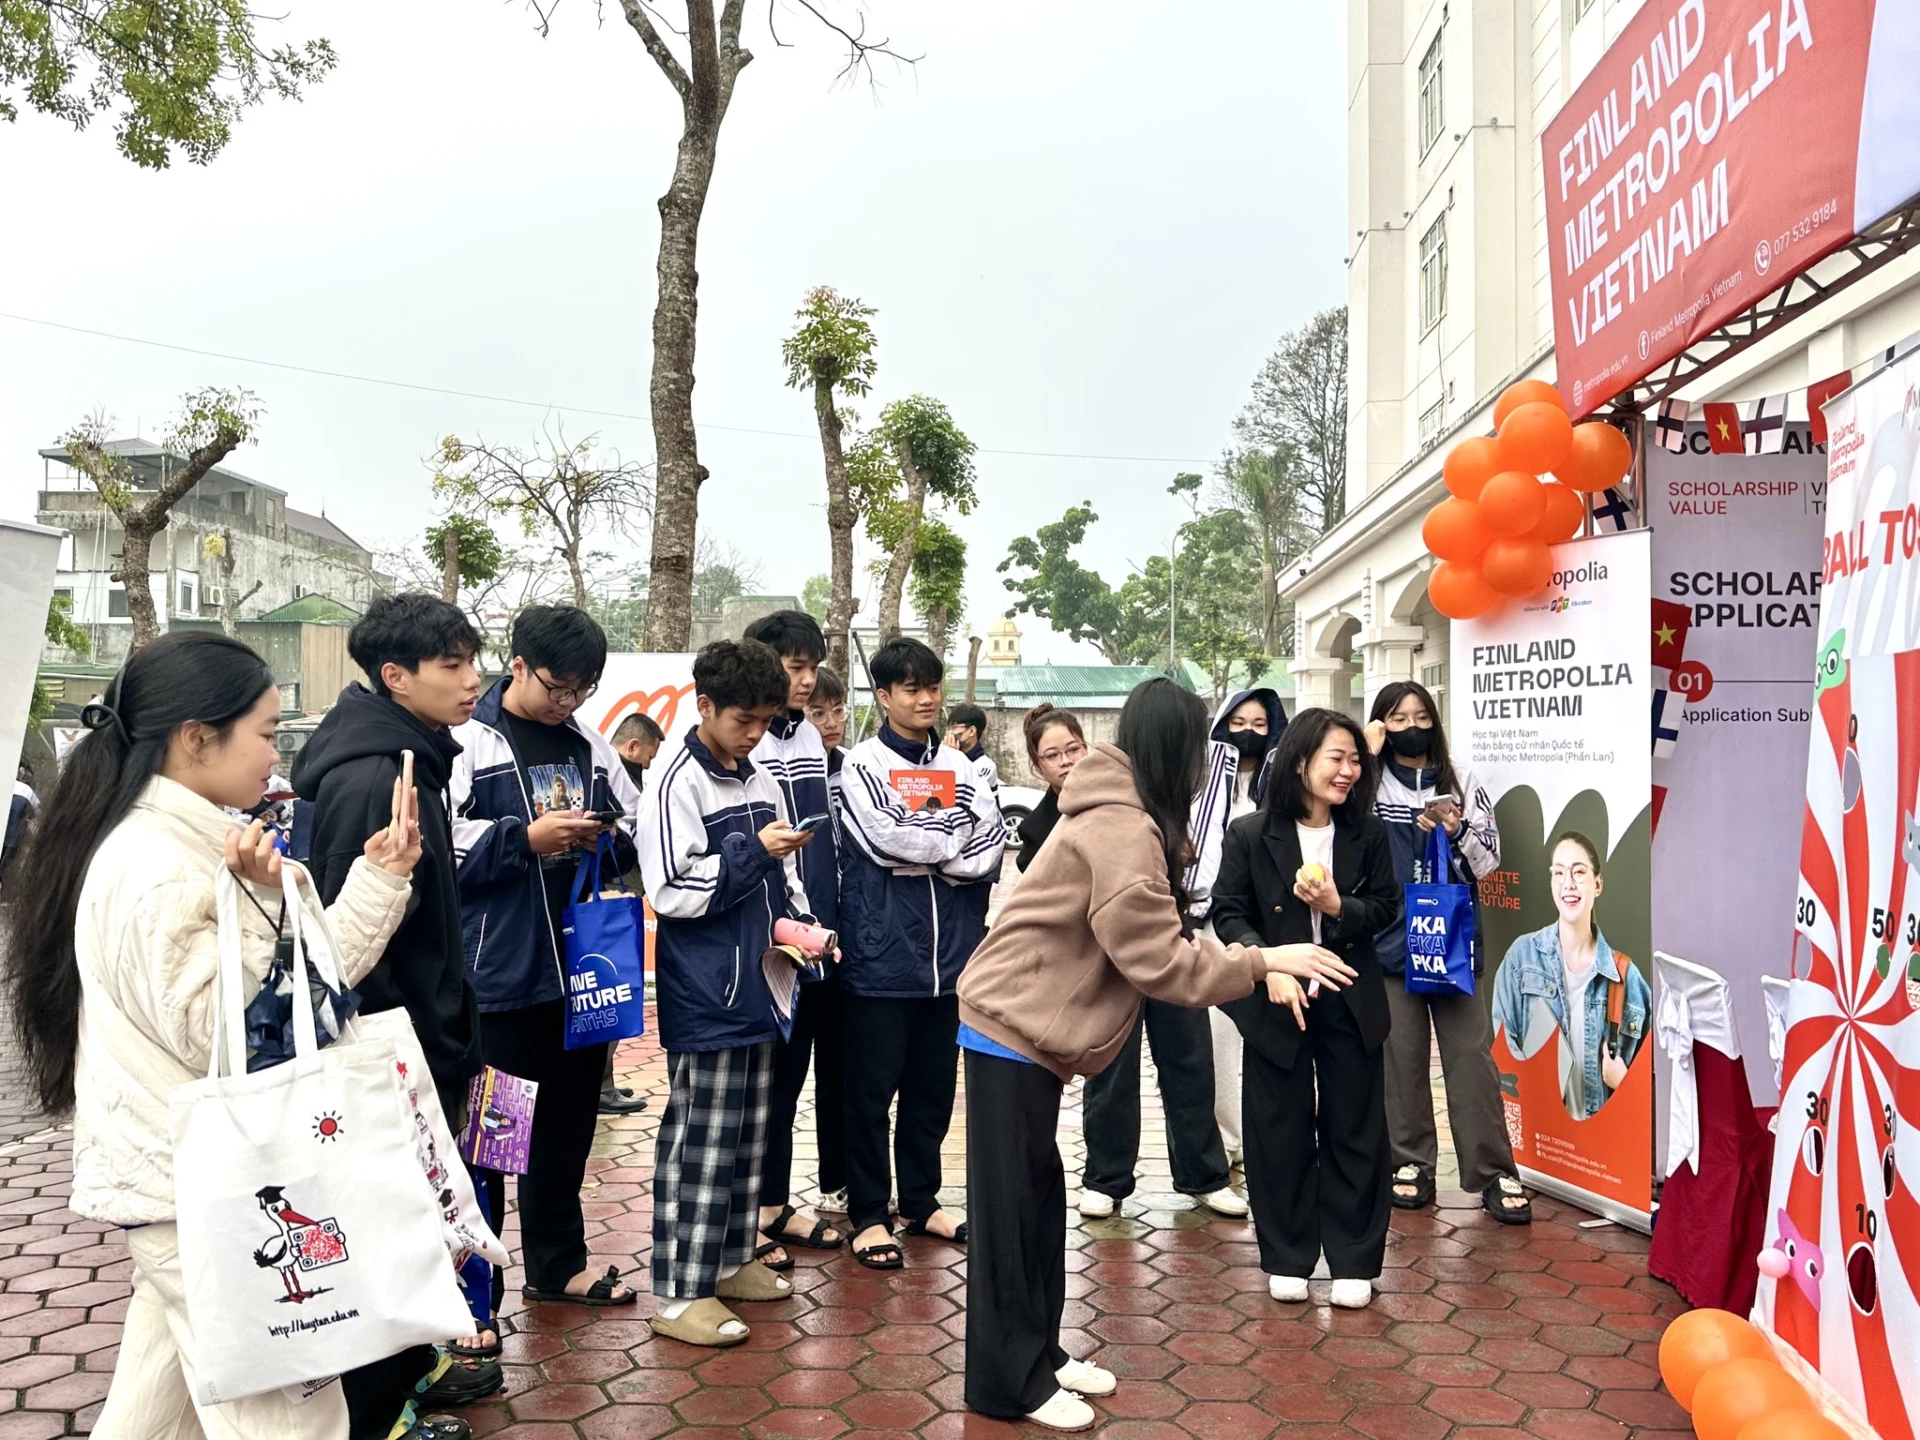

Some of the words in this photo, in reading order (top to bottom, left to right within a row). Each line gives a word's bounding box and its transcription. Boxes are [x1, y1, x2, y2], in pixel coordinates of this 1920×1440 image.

[1559, 0, 1705, 201] FINLAND
[1564, 0, 1814, 276] METROPOLIA
[1773, 231, 1790, 255] 077
[1792, 221, 1811, 243] 532
[1812, 198, 1837, 229] 9184
[1568, 157, 1729, 347] VIETNAM
[1651, 320, 1673, 345] Finland
[1674, 293, 1710, 328] Metropolia
[1710, 270, 1742, 300] Vietnam
[1669, 481, 1798, 496] SCHOLARSHIP
[1669, 500, 1727, 515] VALUE
[1473, 638, 1576, 667] FINLAND
[1473, 663, 1633, 693] METROPOLIA
[1677, 672, 1704, 691] 01
[1473, 695, 1582, 720] VIETNAM
[1777, 708, 1813, 722] Sub
[1472, 730, 1487, 740] Học
[1501, 728, 1516, 739] Việt
[1518, 729, 1538, 738] Nam
[1551, 740, 1572, 751] Quốc
[1519, 752, 1564, 763] Metropolia
[1593, 751, 1615, 764] Lan)
[897, 776, 930, 784] FINLAND
[1797, 896, 1816, 927] 30
[1872, 907, 1895, 942] 50
[1408, 935, 1446, 955] PKA
[1411, 954, 1448, 974] PKA
[1806, 1091, 1829, 1126] 30
[1884, 1104, 1897, 1142] 30
[1856, 1203, 1877, 1242] 10
[268, 1309, 360, 1338] http://duytan.edu.vn
